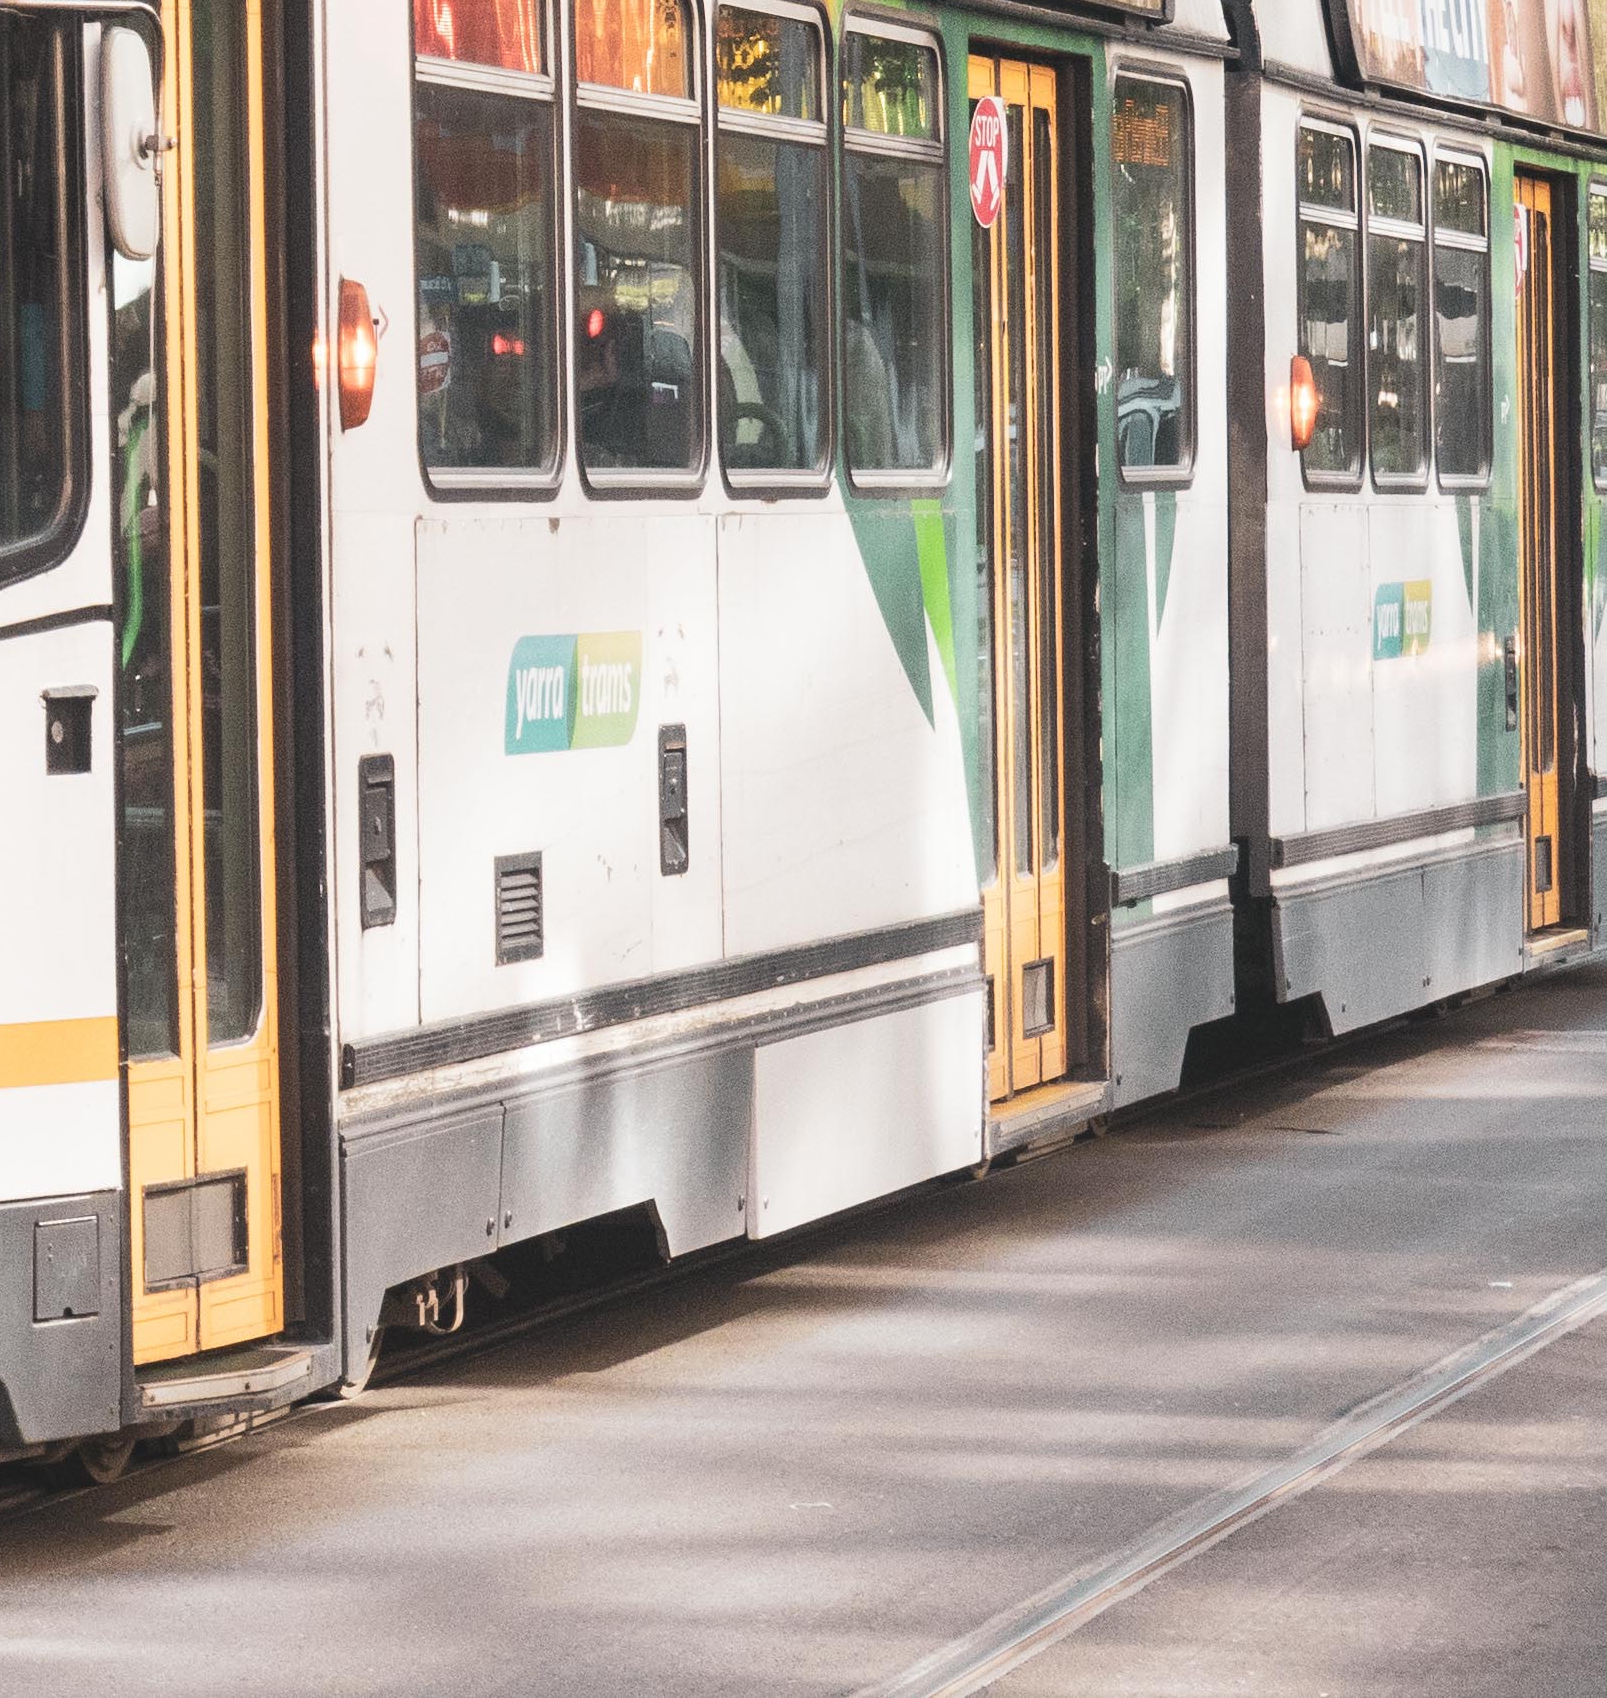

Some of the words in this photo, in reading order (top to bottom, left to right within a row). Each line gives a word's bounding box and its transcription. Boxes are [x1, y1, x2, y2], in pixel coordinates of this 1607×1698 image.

[975, 115, 1000, 148] STOP
[515, 664, 565, 741] yarra
[581, 653, 632, 718] trams
